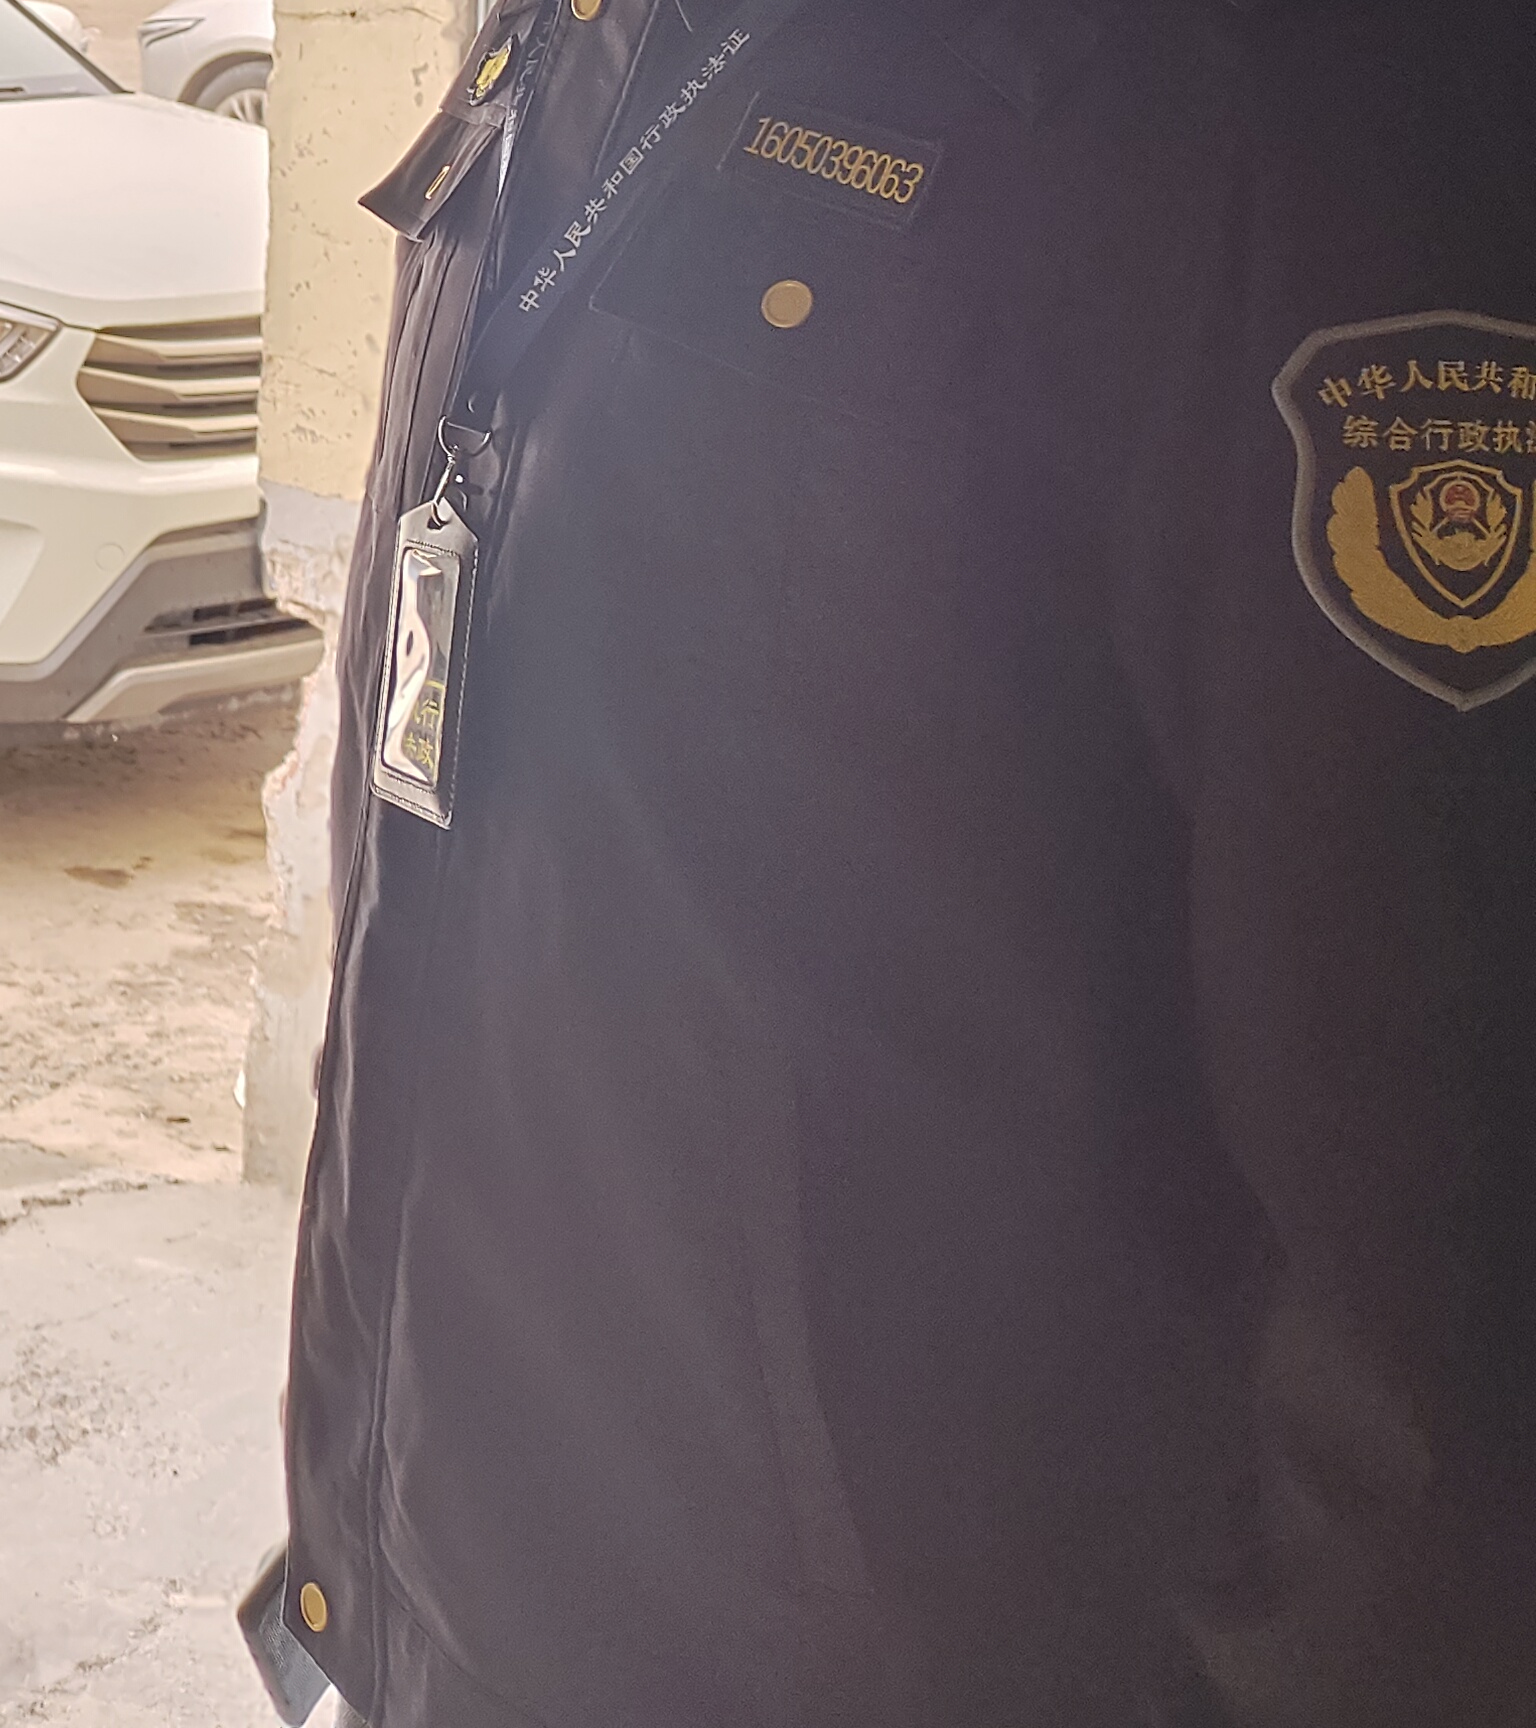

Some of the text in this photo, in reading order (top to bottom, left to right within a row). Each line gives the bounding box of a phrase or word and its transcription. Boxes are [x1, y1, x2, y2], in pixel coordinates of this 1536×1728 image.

[518, 28, 750, 312] 中华人民共和国行政执法证
[743, 117, 924, 203] 16050396063
